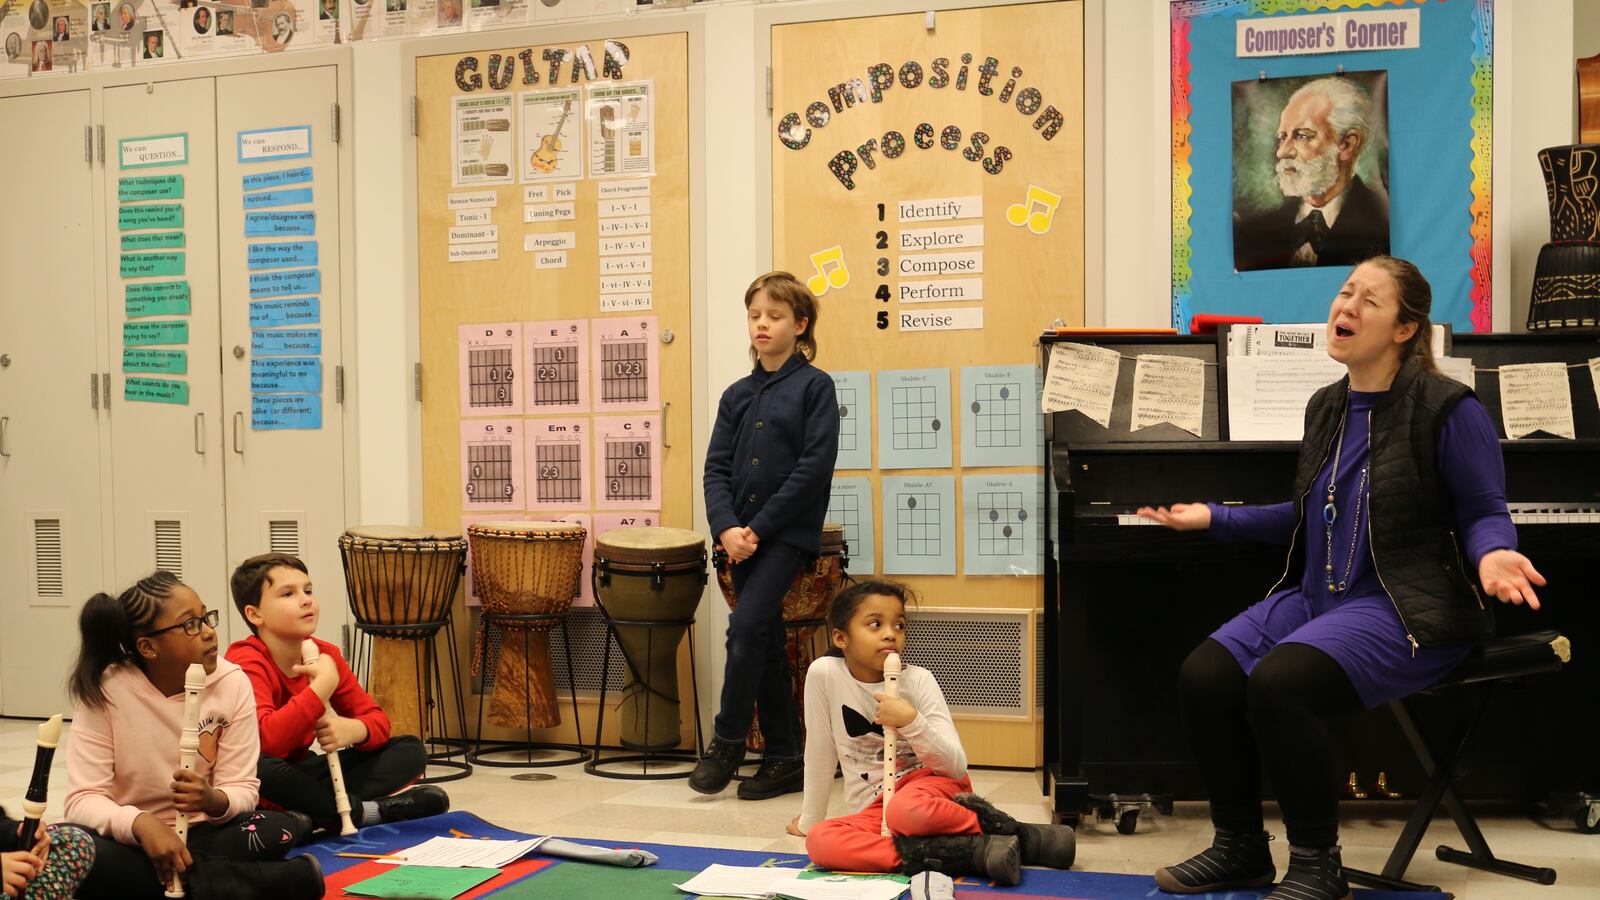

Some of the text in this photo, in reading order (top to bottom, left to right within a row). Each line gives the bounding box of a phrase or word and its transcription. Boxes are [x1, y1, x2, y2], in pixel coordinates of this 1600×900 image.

[1245, 20, 1407, 53] Composer's Corner
[455, 39, 630, 92] GUITAR
[778, 52, 1064, 150] Composition
[262, 144, 304, 152] RESPOND...
[828, 123, 1012, 190] Process
[877, 202, 961, 222] 1 Identify
[534, 238, 566, 247] Arpeggio
[876, 231, 964, 249] 2 Explore
[877, 258, 975, 276] 3 Compose
[875, 284, 964, 302] 4 Perform
[877, 311, 952, 329] 5 Revise
[557, 351, 562, 360] 1
[618, 365, 622, 373] 1
[625, 365, 632, 374] 2
[634, 364, 640, 373] 3
[492, 371, 497, 379] 1
[507, 370, 512, 379] 2
[540, 369, 546, 378] 2
[550, 369, 555, 378] 3
[500, 389, 505, 398] 3
[638, 446, 642, 454] 1
[543, 468, 548, 477] 2
[552, 468, 557, 477] 3
[620, 464, 626, 472] 2
[468, 485, 473, 493] 2
[506, 486, 511, 494] 3
[613, 482, 618, 491] 3
